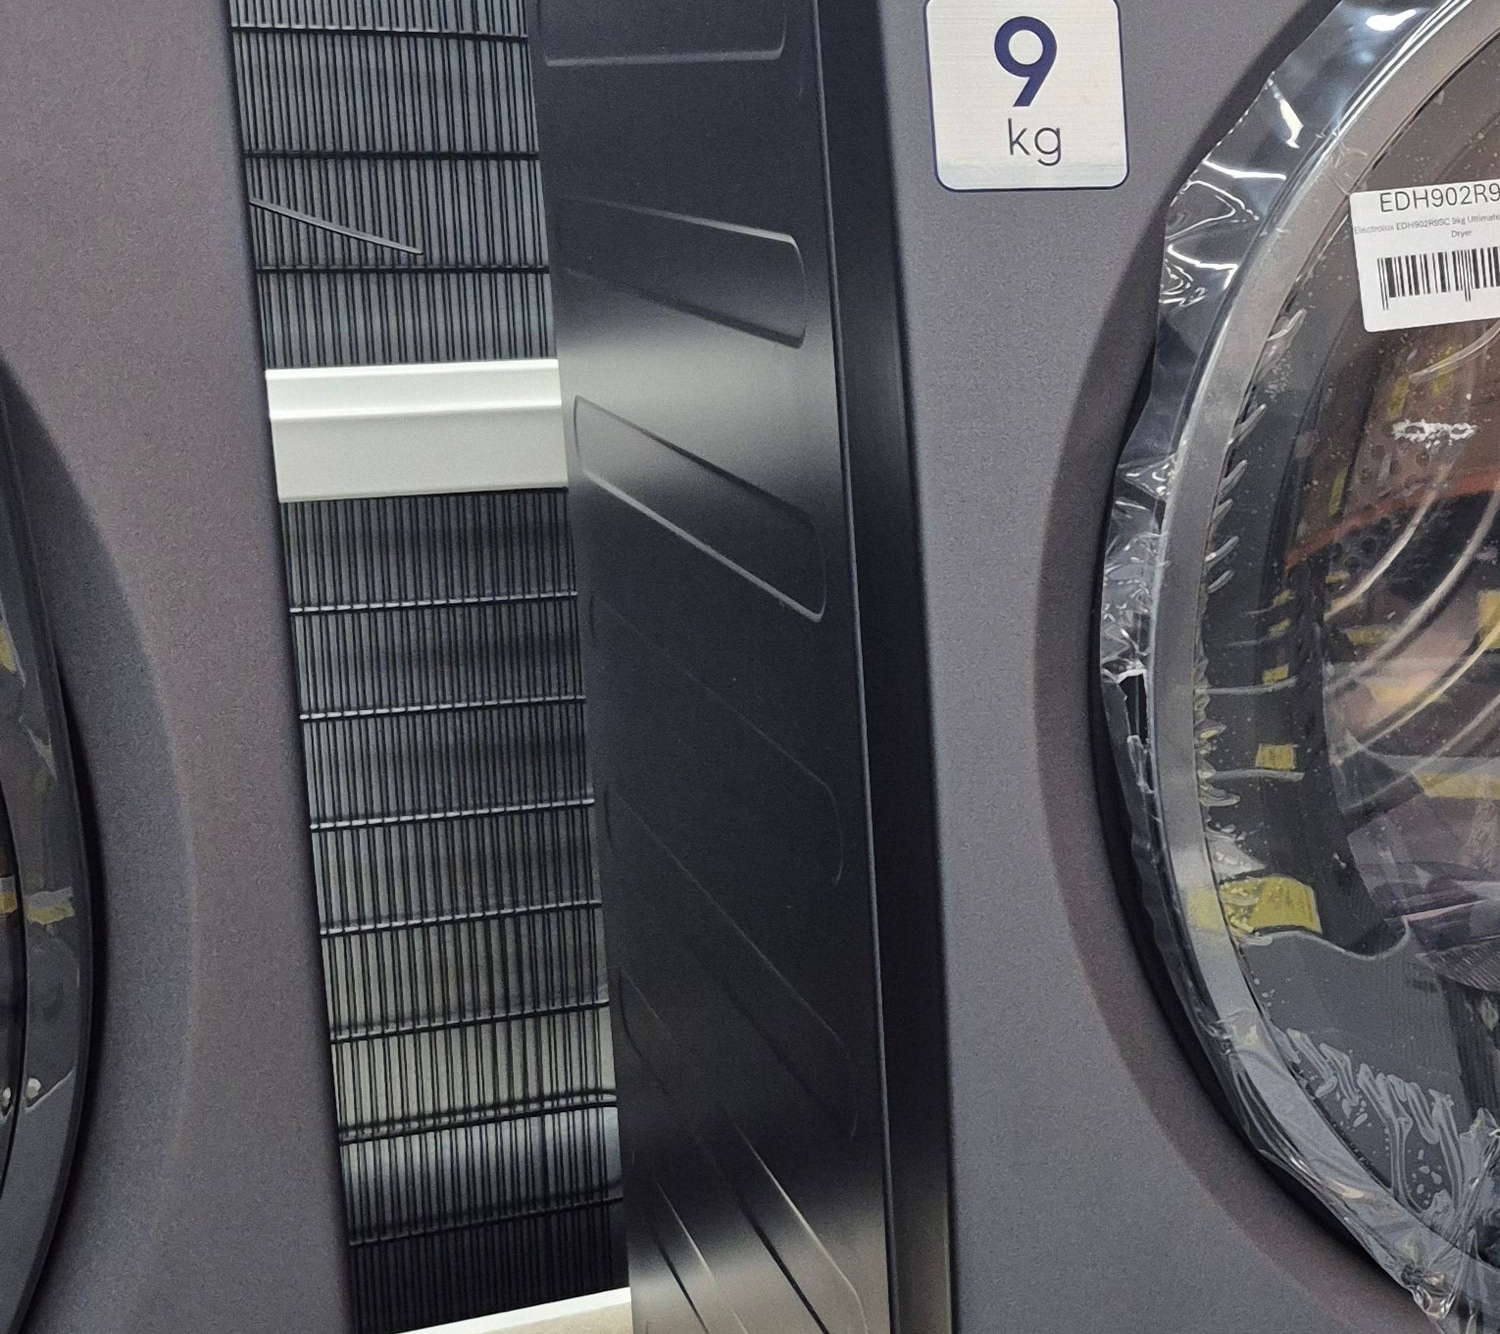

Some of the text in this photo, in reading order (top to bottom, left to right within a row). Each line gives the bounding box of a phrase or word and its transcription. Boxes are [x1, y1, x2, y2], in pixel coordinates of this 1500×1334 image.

[994, 16, 1057, 107] 9
[1007, 118, 1062, 166] kg
[1451, 228, 1472, 239] Dryer
